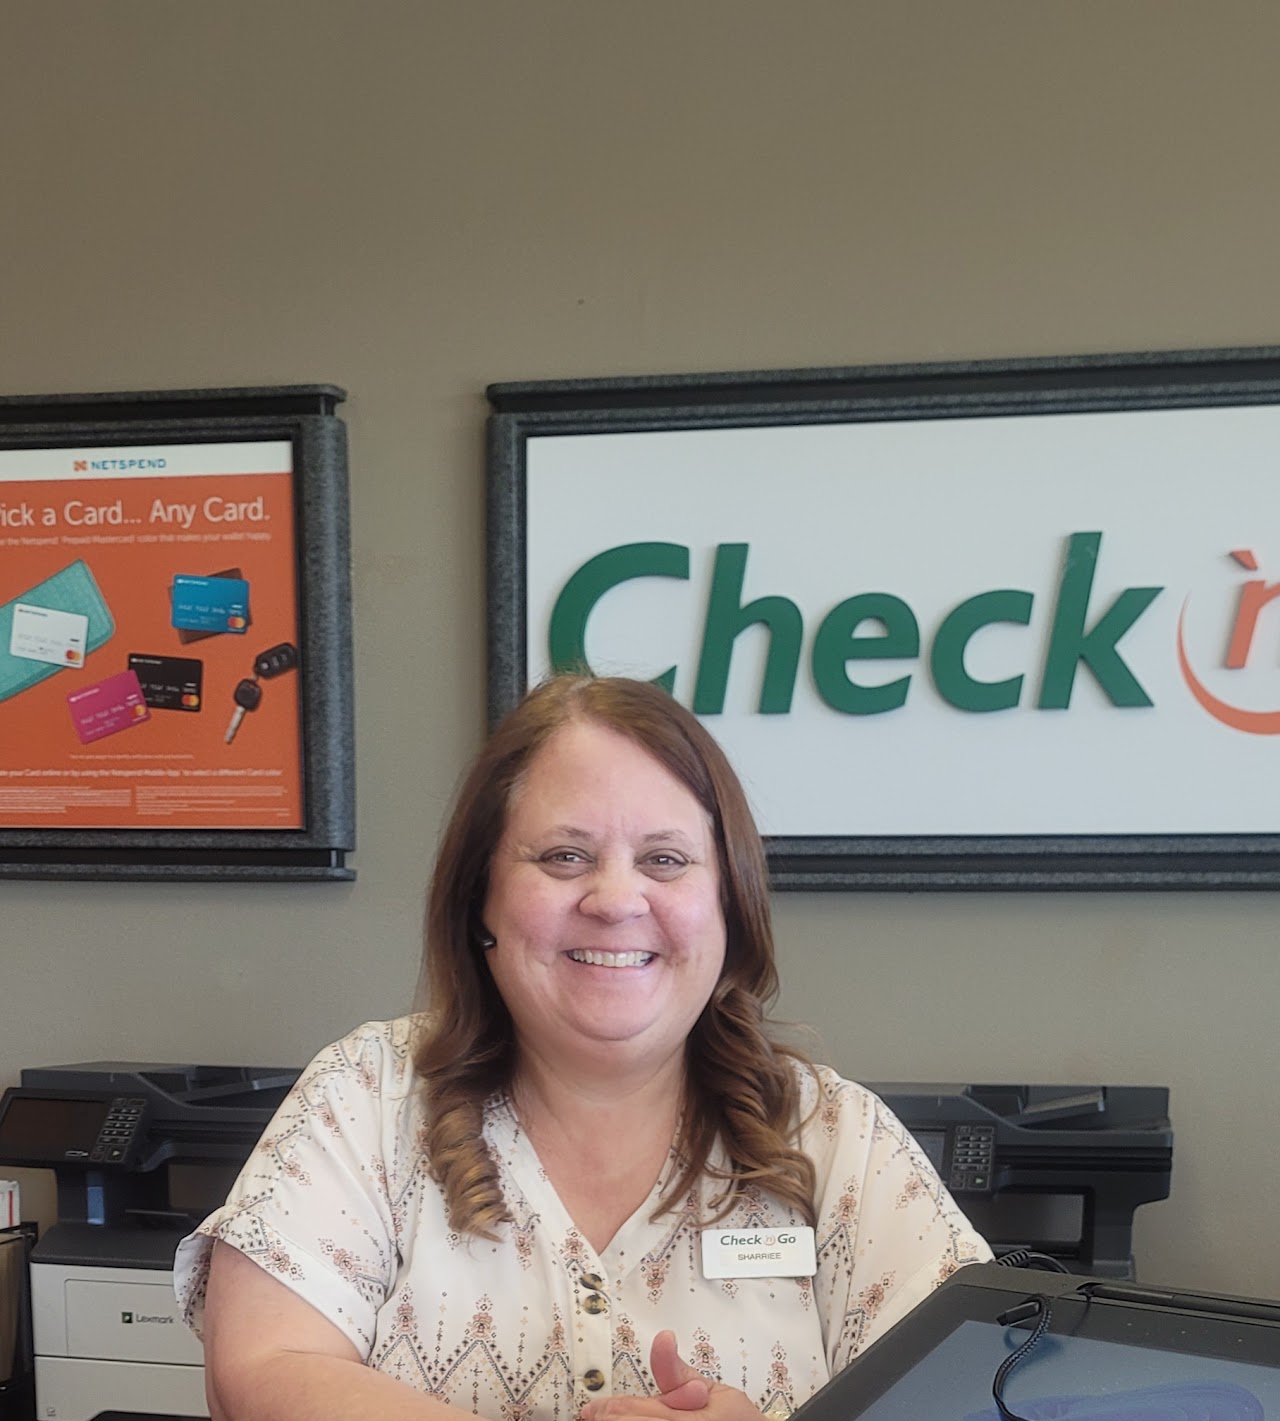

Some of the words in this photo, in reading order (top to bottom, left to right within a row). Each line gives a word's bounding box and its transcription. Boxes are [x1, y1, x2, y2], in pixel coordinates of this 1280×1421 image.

[91, 459, 166, 470] NETSPEND
[0, 503, 35, 527] ick
[42, 507, 56, 526] a
[63, 499, 141, 526] Card...
[149, 498, 196, 529] Any
[203, 495, 270, 522] Card.
[548, 531, 1166, 716] Check
[720, 1235, 762, 1246] Check
[777, 1233, 796, 1244] Go
[136, 1314, 174, 1323] Lexmark
